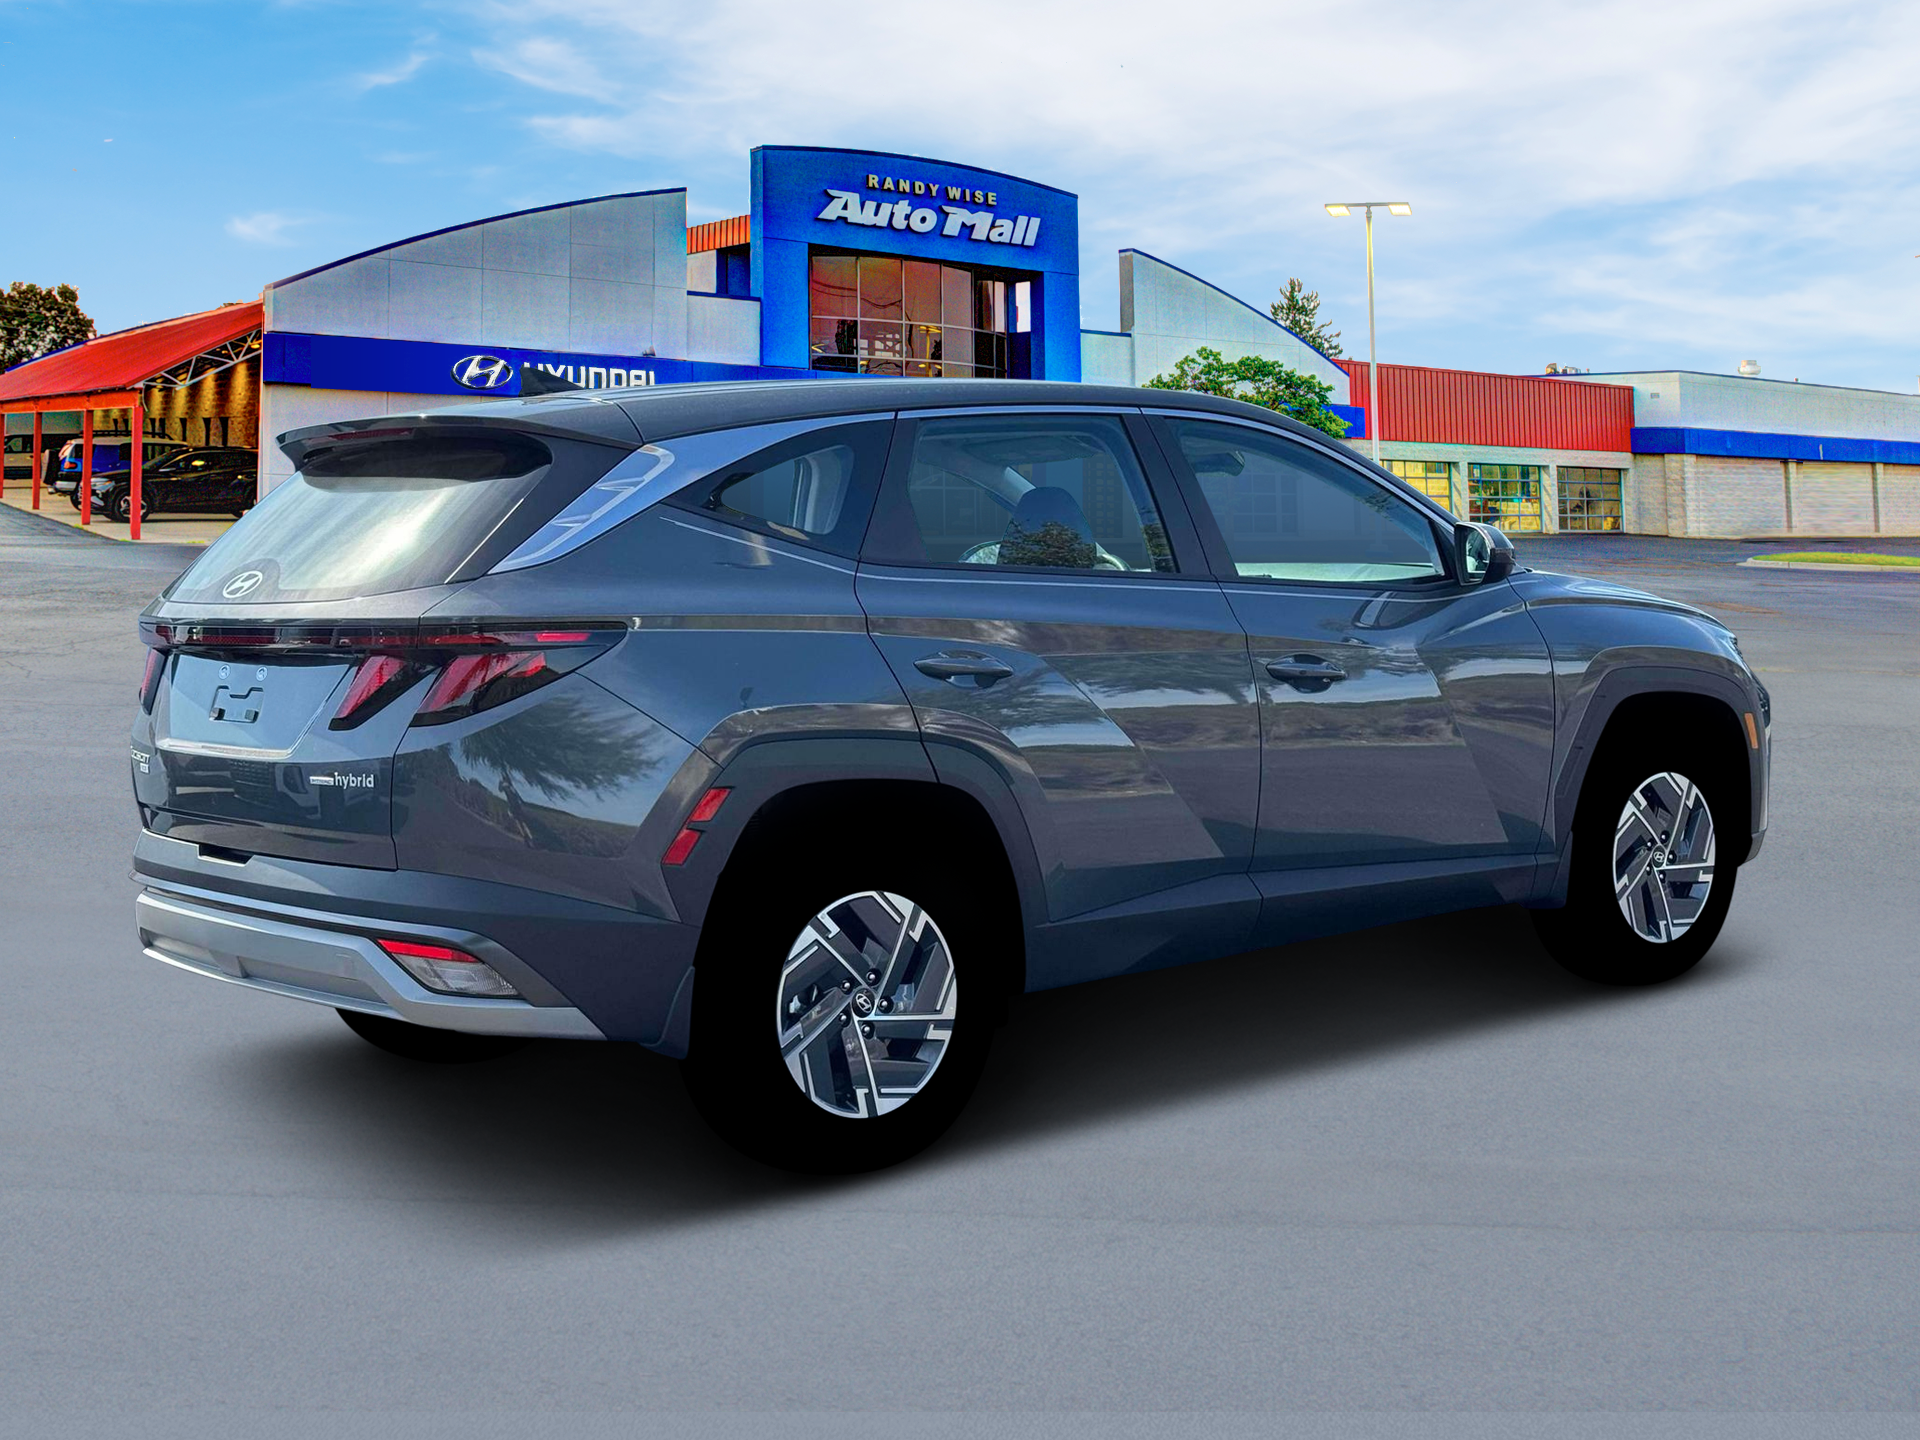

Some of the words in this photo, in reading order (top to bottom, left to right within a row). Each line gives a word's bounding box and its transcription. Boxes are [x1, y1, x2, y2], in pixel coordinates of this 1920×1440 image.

[867, 174, 939, 197] RANDY
[947, 186, 997, 205] WISE
[817, 189, 937, 233] Auto
[942, 205, 1041, 247] Mall
[523, 361, 656, 388] YUNDAI
[334, 771, 374, 790] hybrid
